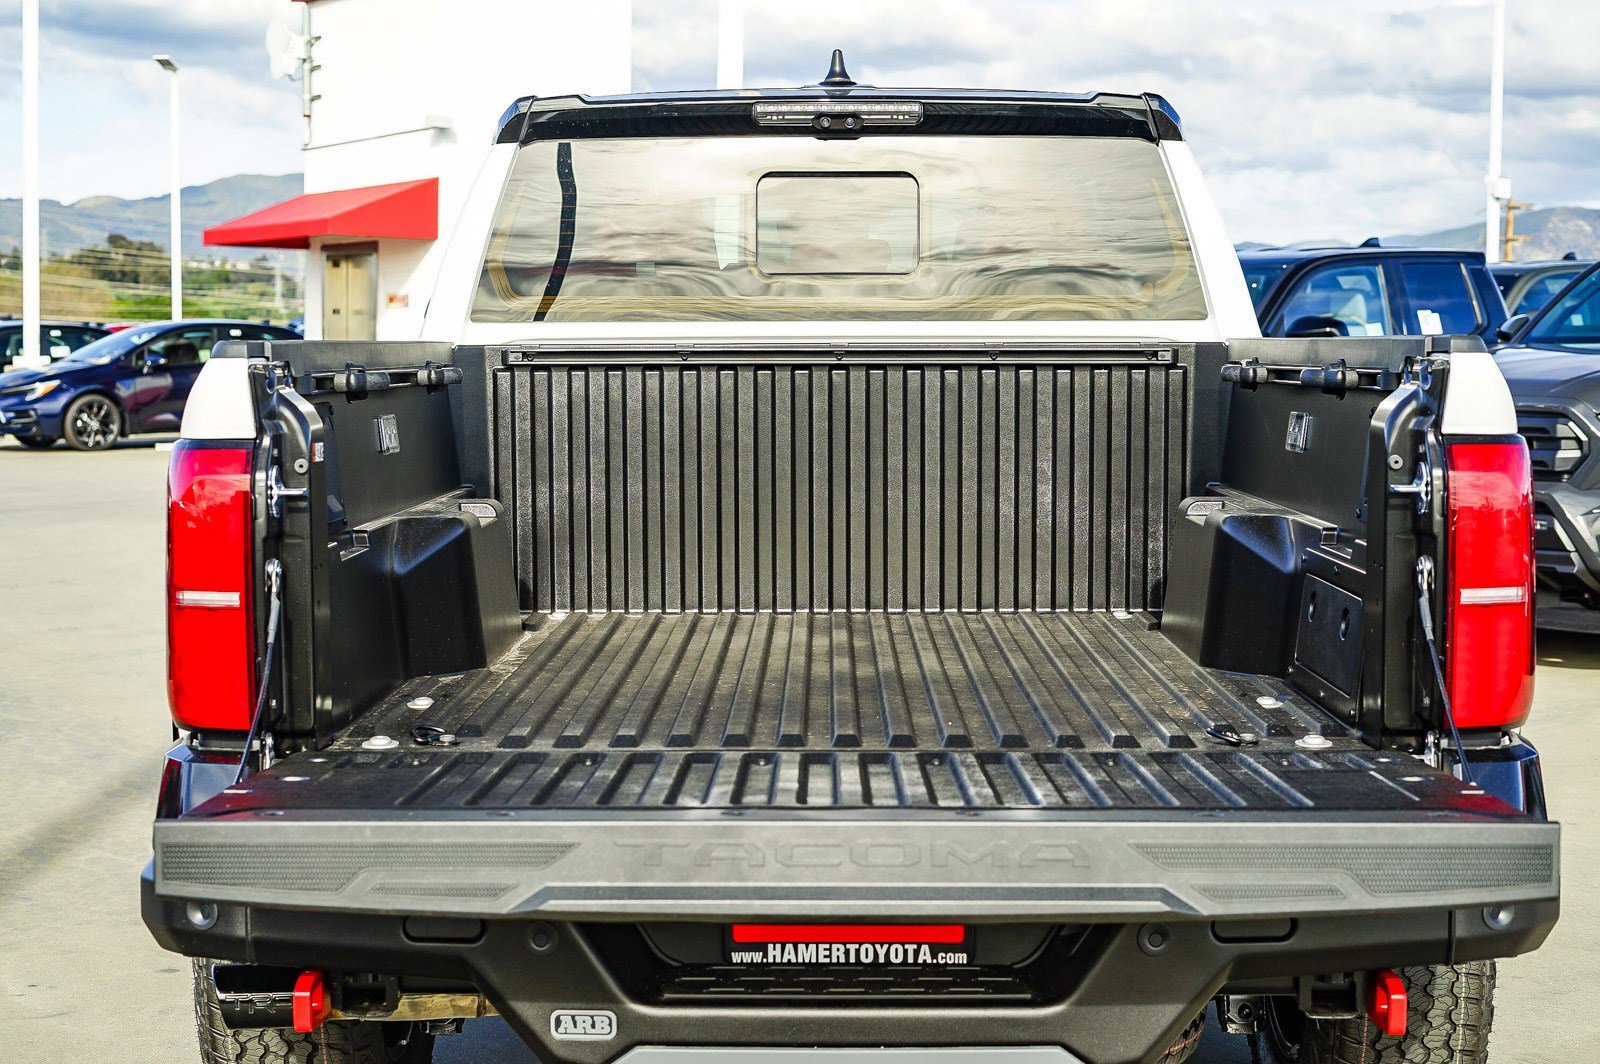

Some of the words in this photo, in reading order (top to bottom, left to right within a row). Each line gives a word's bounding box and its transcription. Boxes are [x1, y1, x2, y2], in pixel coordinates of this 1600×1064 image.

[613, 840, 1091, 868] TACOMA
[731, 943, 968, 964] www.HAMERTOYOTA.com
[557, 1015, 612, 1035] ARB
